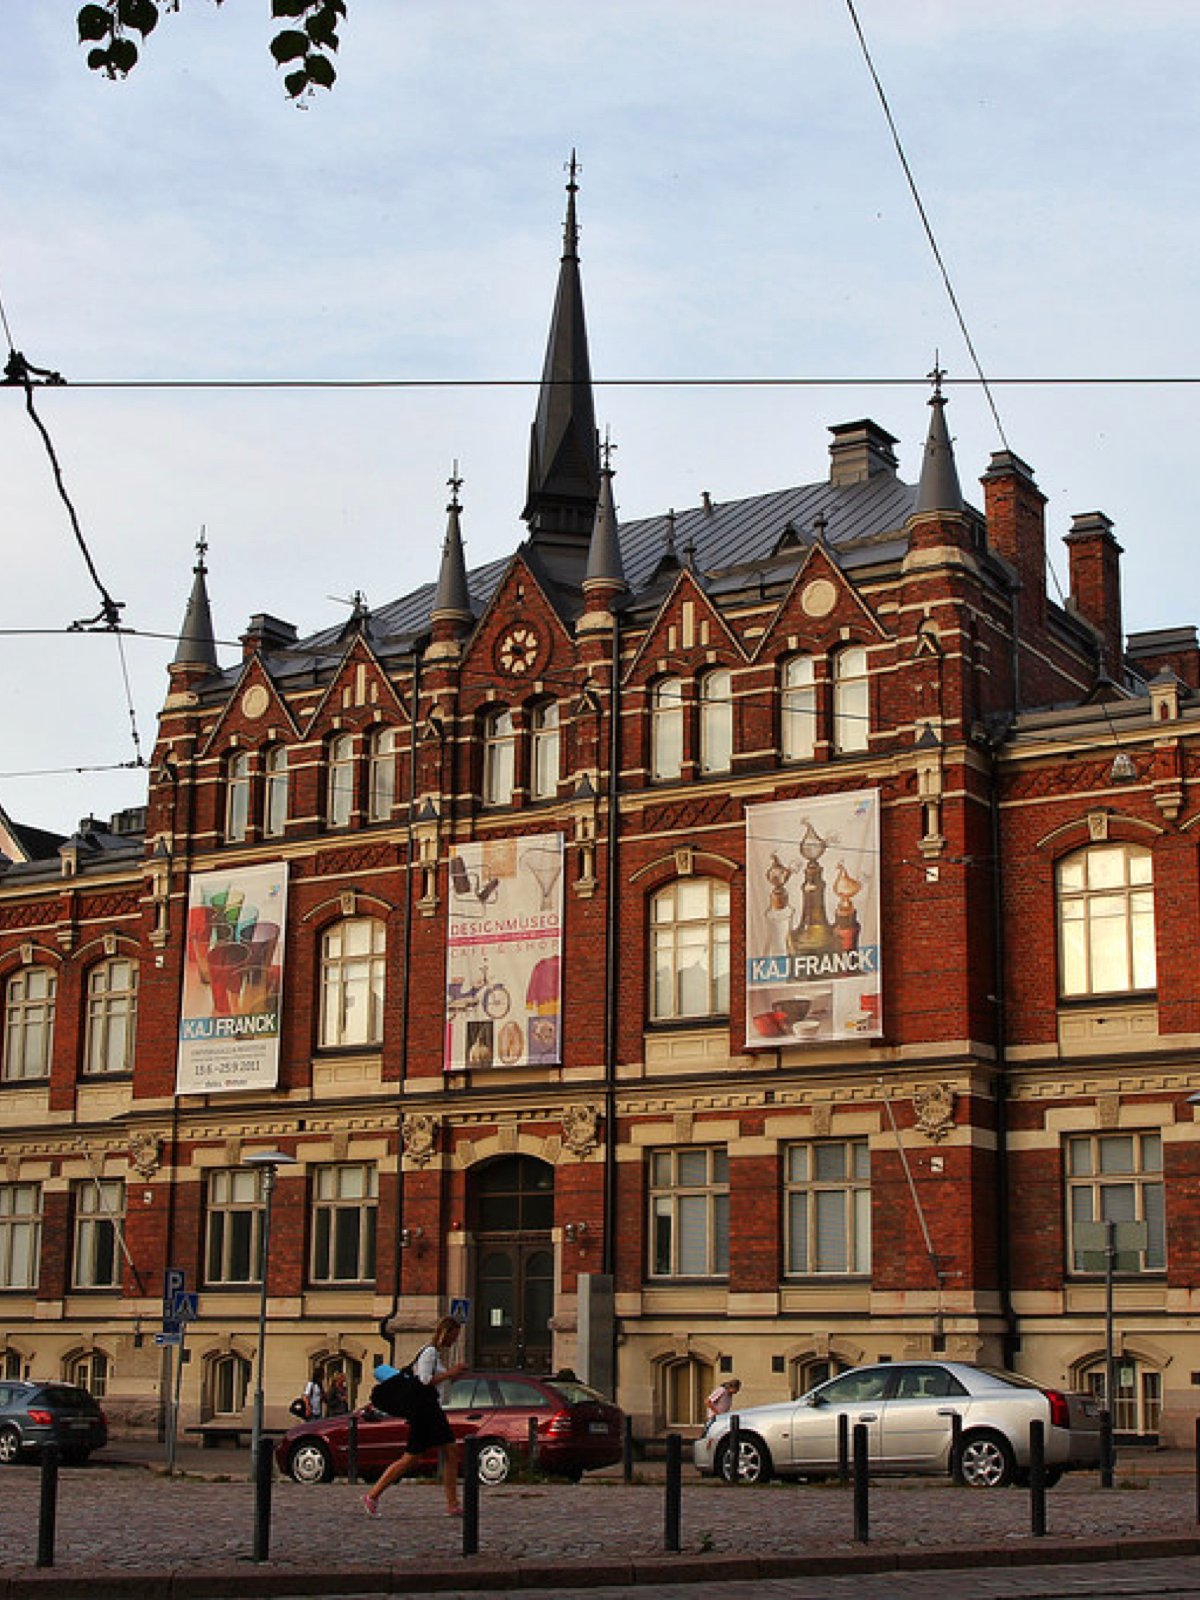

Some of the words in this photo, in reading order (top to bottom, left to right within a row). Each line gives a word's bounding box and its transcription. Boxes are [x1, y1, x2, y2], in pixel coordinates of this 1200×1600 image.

[451, 914, 559, 936] DESIGNMUSEO
[752, 958, 789, 980] KAJ
[795, 949, 874, 978] FRANCK
[183, 1020, 213, 1039] KAJ
[216, 1013, 276, 1036] FRANCK
[167, 1271, 183, 1299] P
